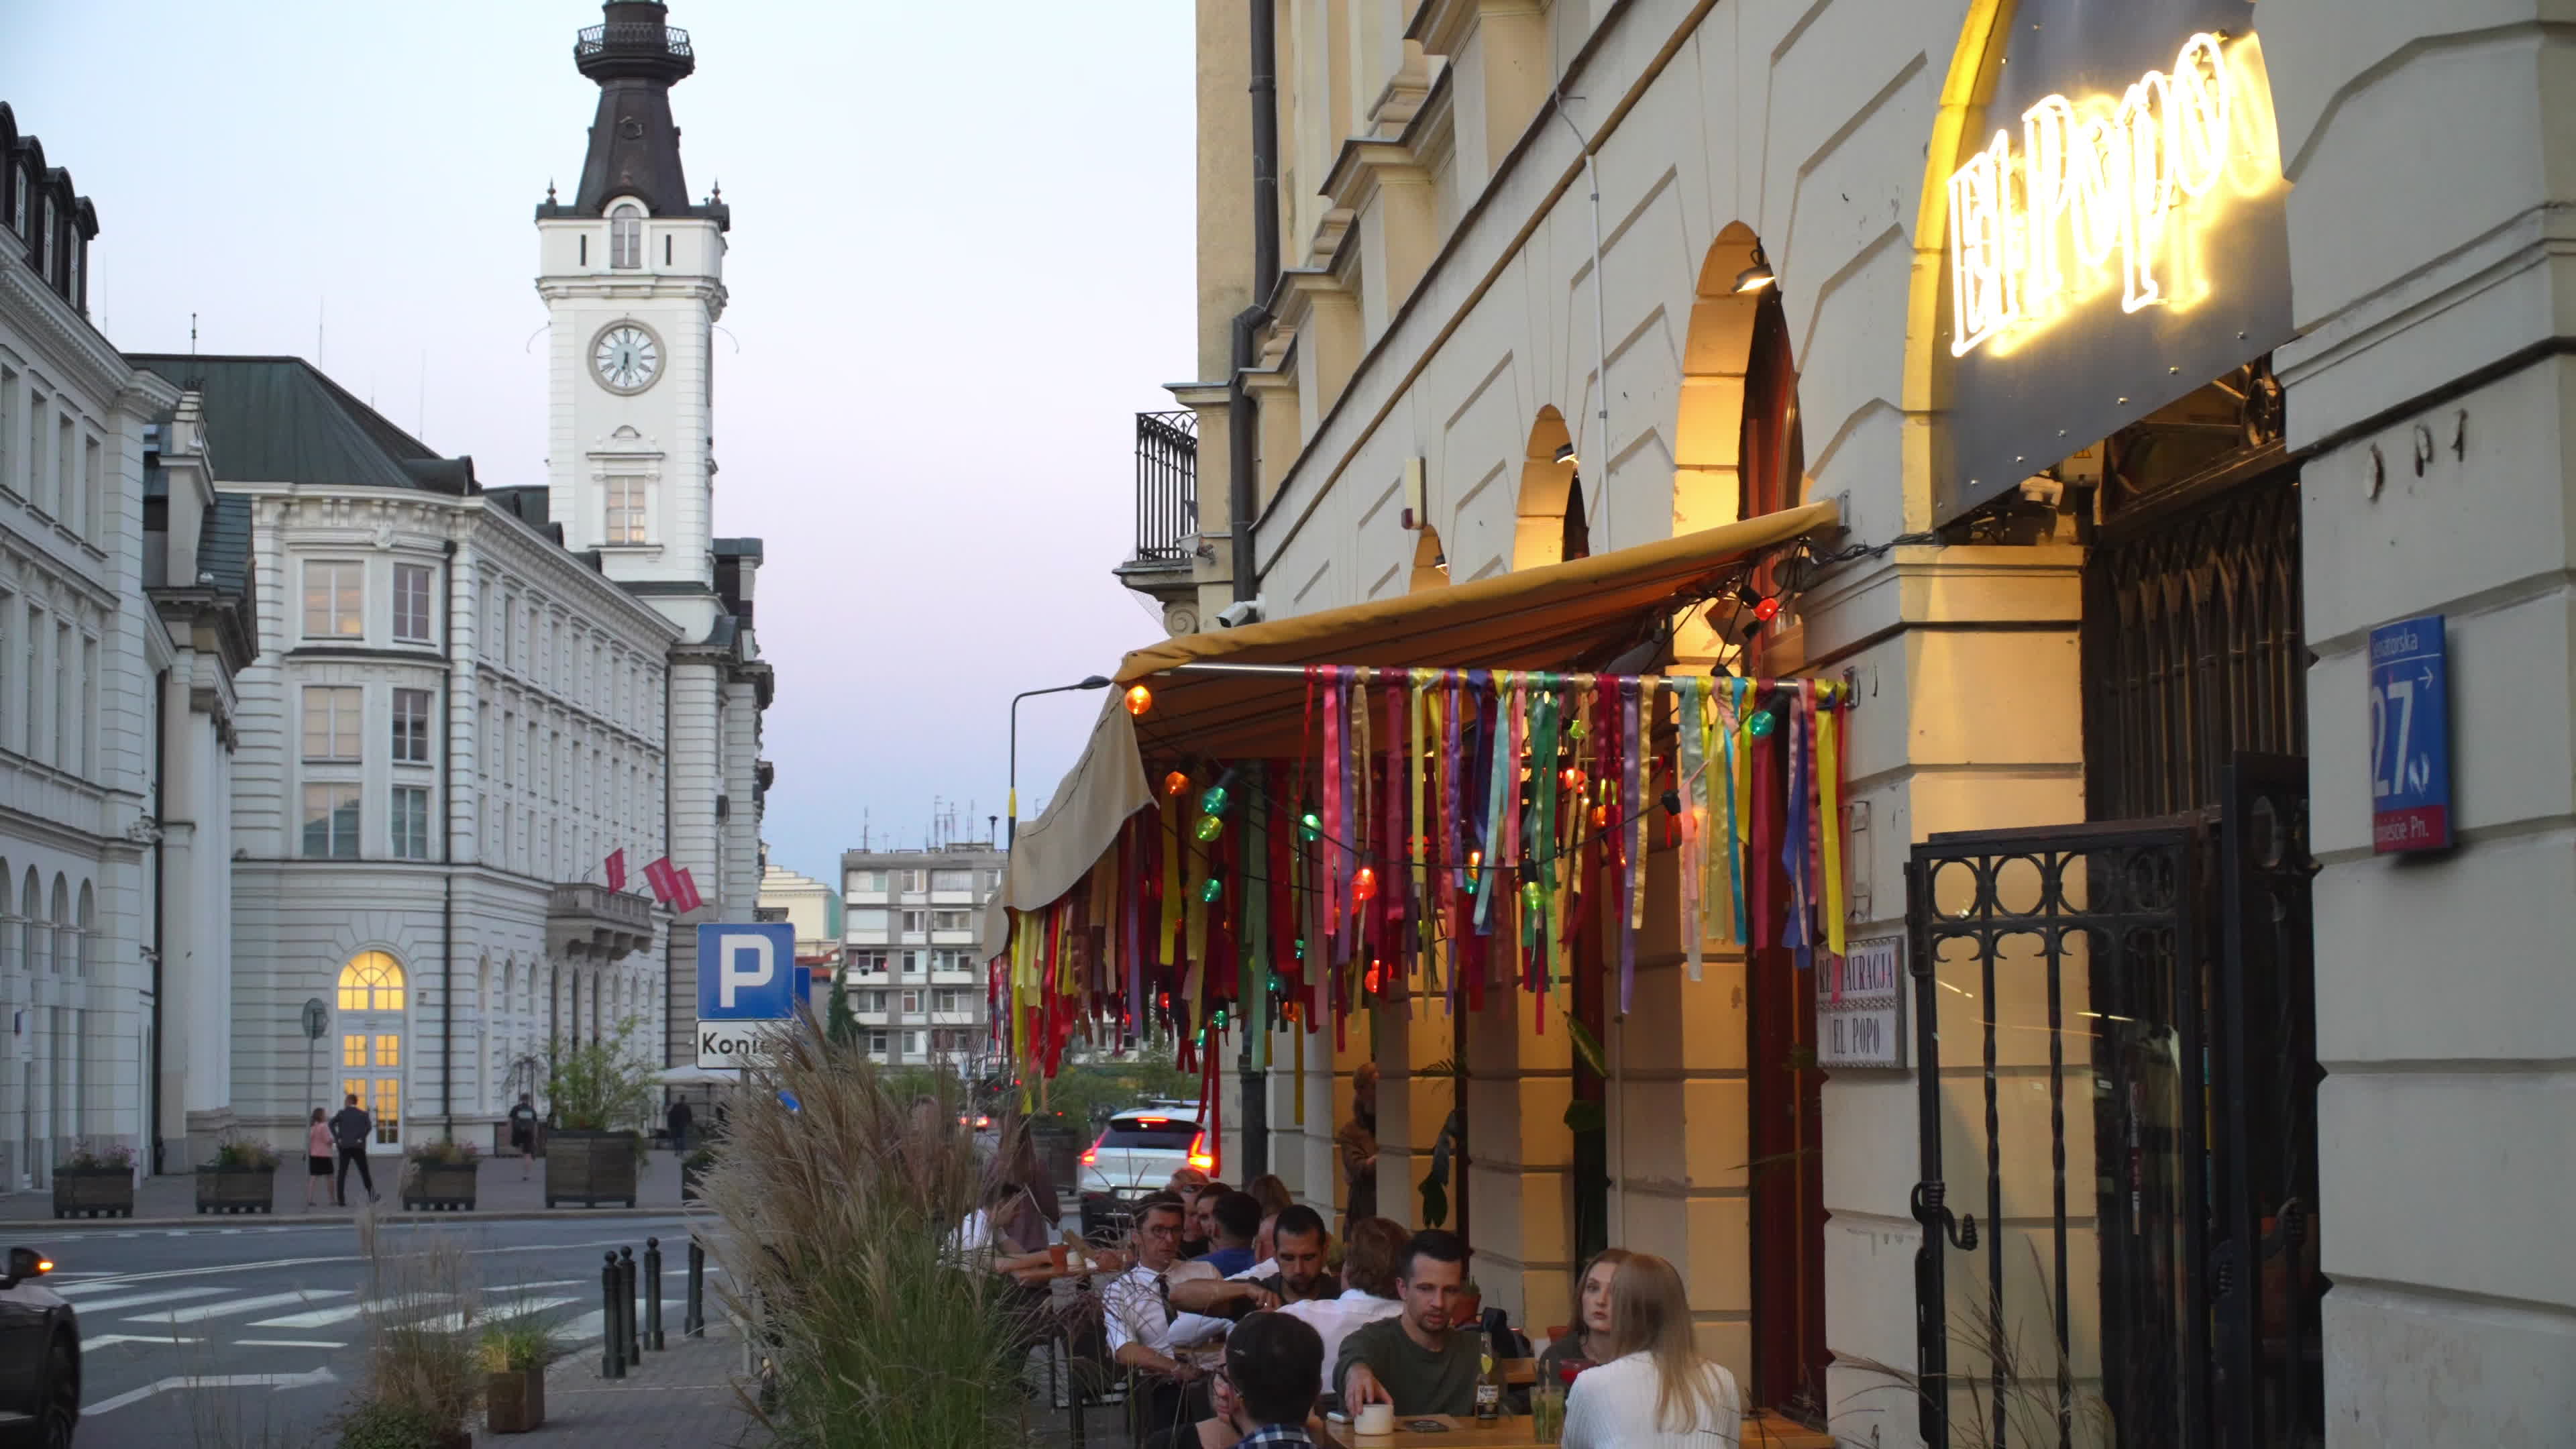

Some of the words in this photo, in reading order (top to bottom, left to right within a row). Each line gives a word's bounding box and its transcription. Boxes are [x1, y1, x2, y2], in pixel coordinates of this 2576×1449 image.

[2372, 680, 2414, 796] 27
[720, 934, 773, 1008] P
[1819, 953, 1893, 993] RETAURACJA
[1833, 1018, 1845, 1054] EL
[1853, 1018, 1880, 1055] POPO
